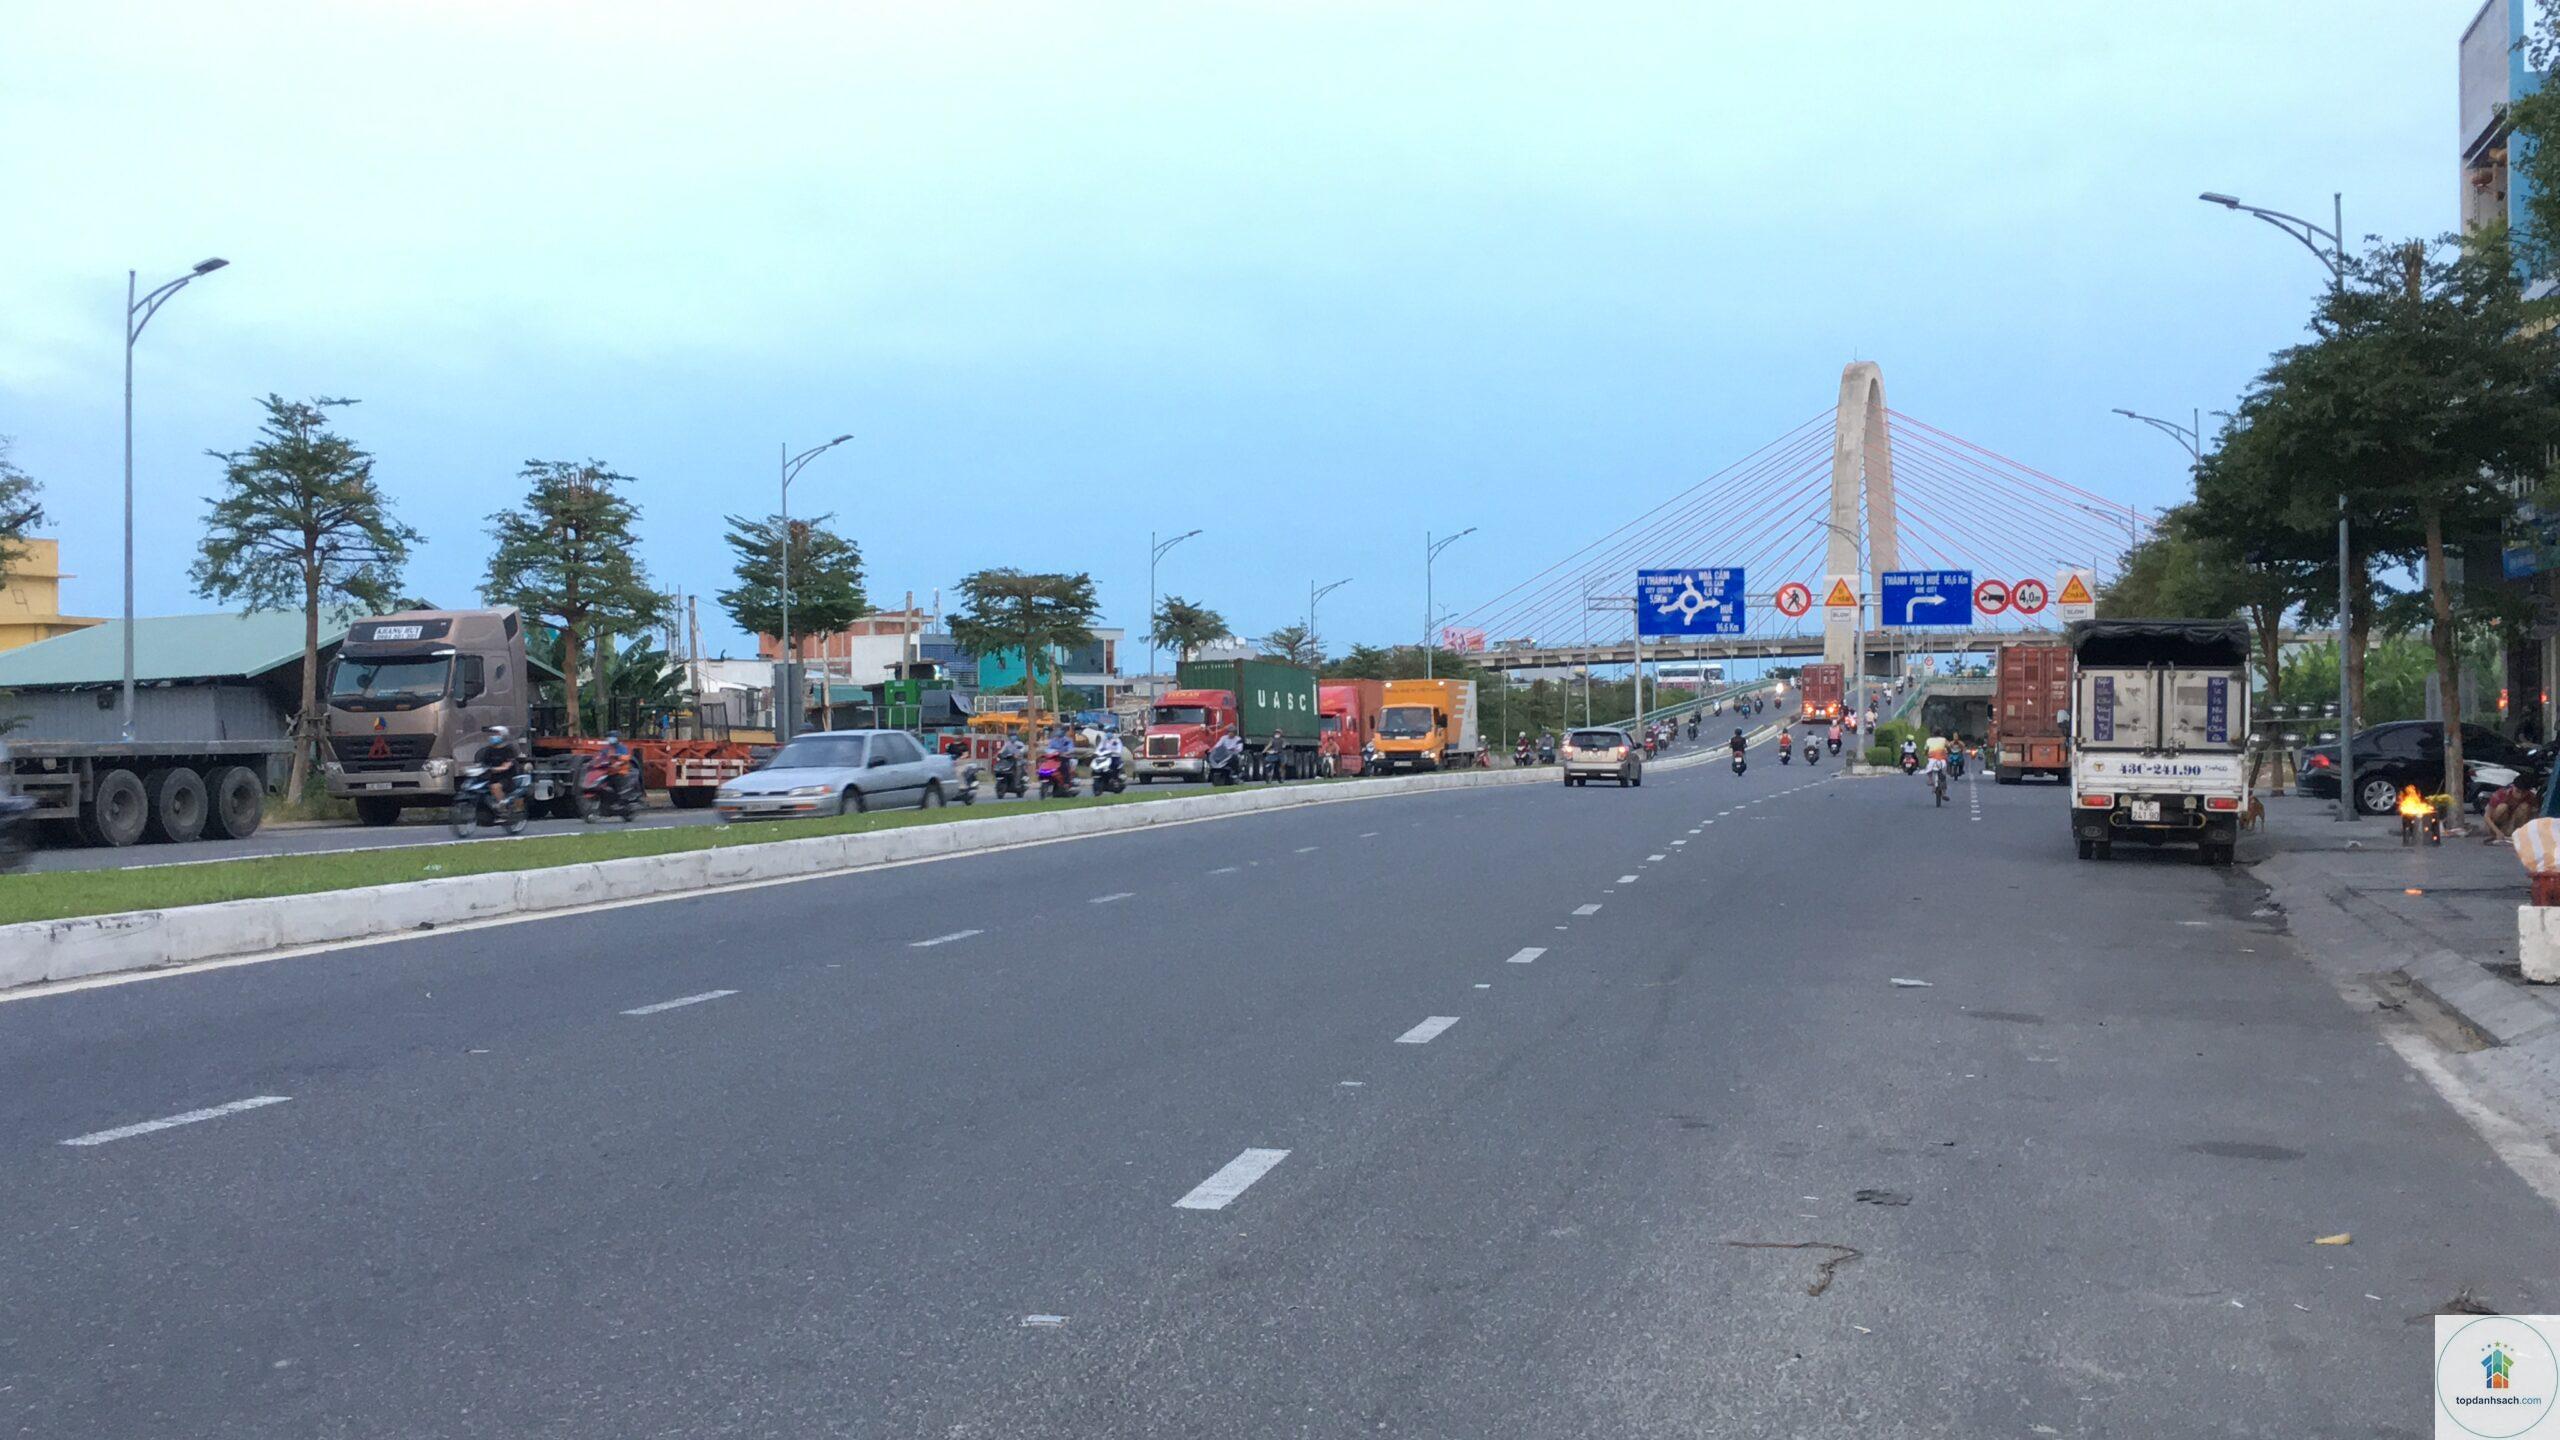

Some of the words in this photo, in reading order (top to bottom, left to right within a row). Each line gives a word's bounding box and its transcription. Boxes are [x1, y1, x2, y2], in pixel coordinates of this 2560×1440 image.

[1884, 574, 1907, 586] THÀNH
[1910, 573, 1925, 585] PHỐ
[1926, 572, 1940, 585] HUẾ
[1958, 576, 1969, 585] Km
[1257, 689, 1307, 712] UASC
[2119, 762, 2202, 776] 43C-241.90
